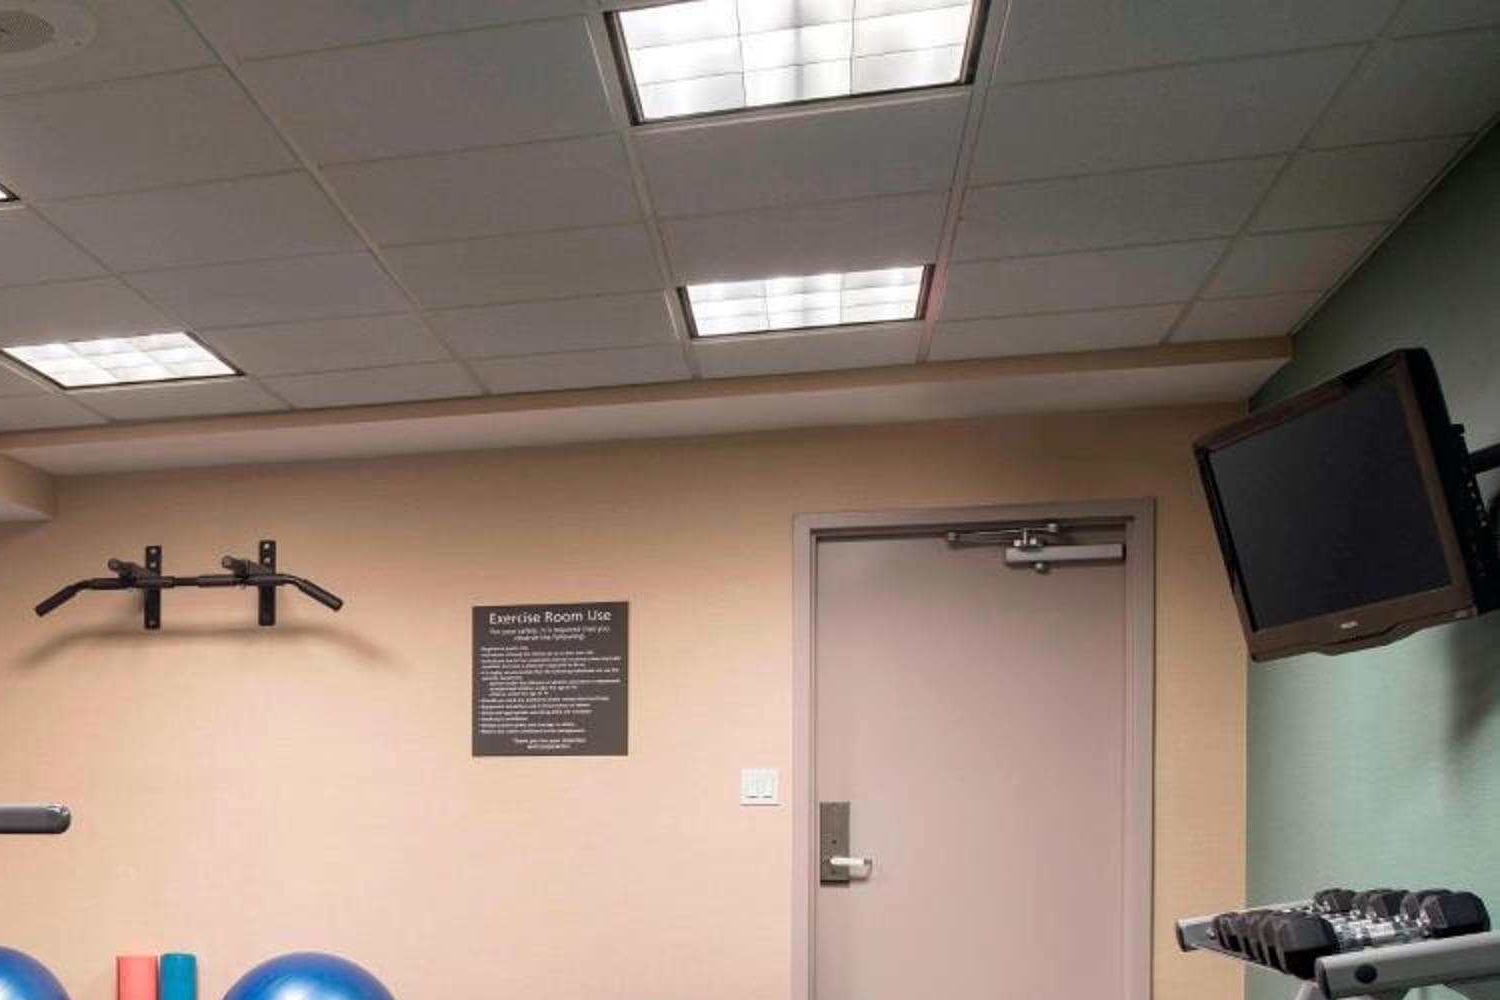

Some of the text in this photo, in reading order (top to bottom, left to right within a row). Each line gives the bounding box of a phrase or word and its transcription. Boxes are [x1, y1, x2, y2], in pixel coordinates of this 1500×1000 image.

[488, 608, 612, 625] Exercise Room Use
